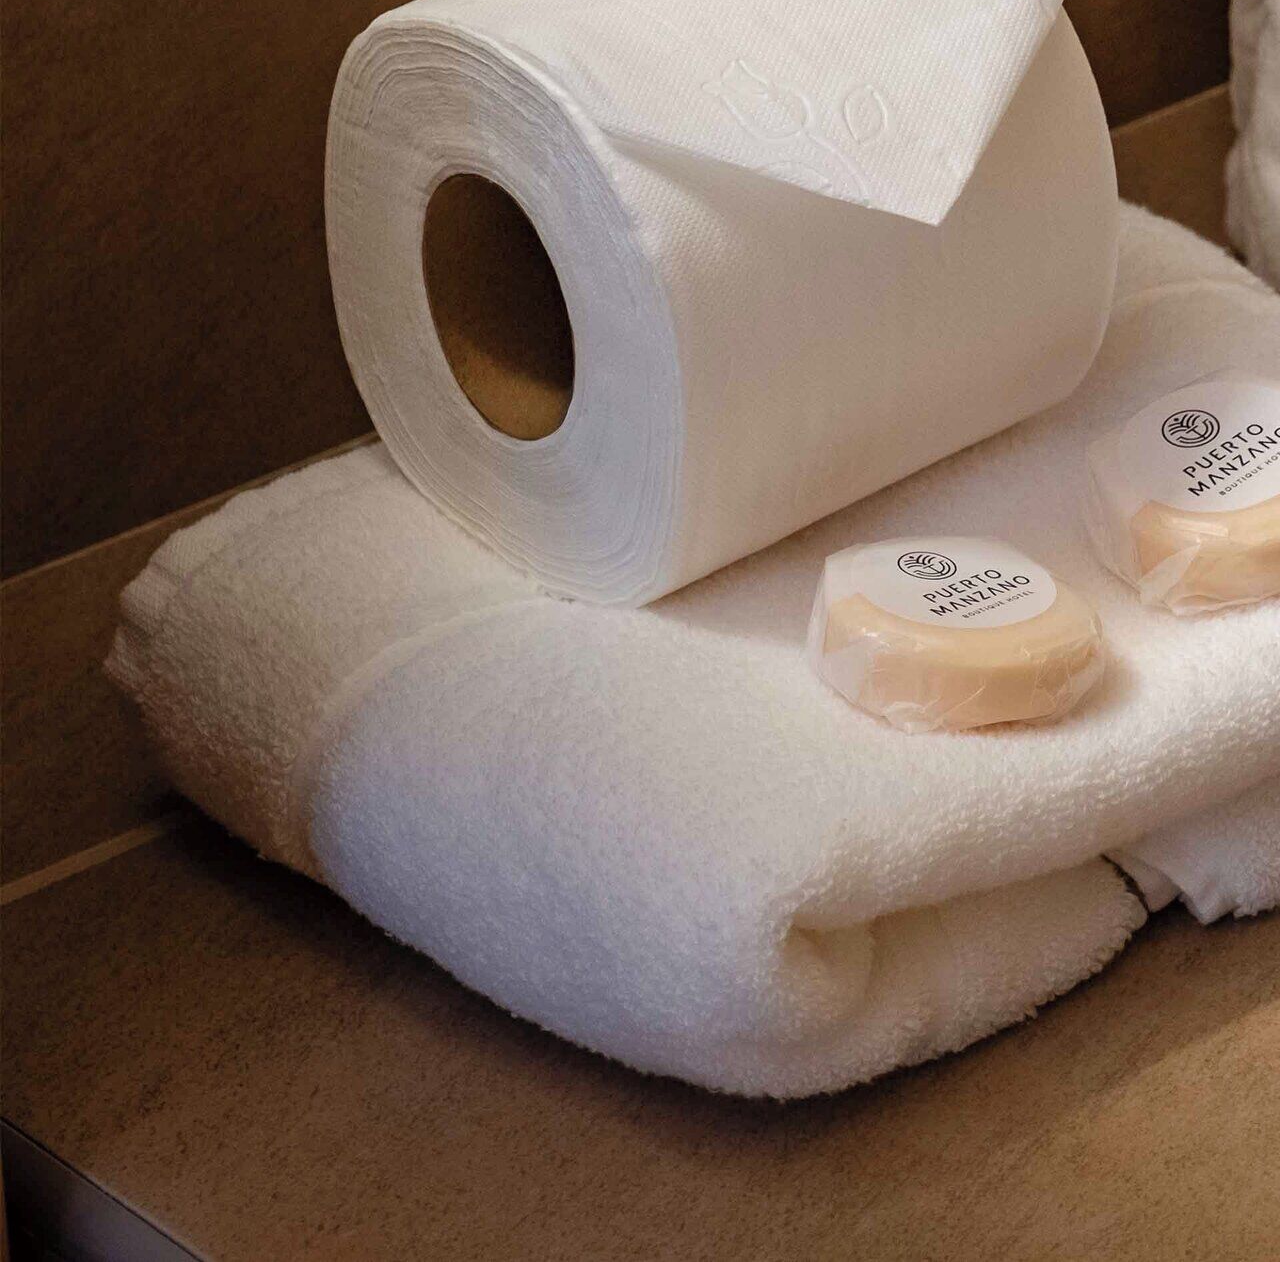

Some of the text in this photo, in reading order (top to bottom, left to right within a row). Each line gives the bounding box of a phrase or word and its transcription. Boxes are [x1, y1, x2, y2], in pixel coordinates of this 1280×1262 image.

[1183, 423, 1263, 478] PUERTO
[1219, 466, 1264, 496] BOUTIQUE
[923, 569, 1001, 603] PUERTO
[929, 575, 1030, 617] MANZANO
[962, 590, 1036, 619] BOUTIQUE HOTEL
